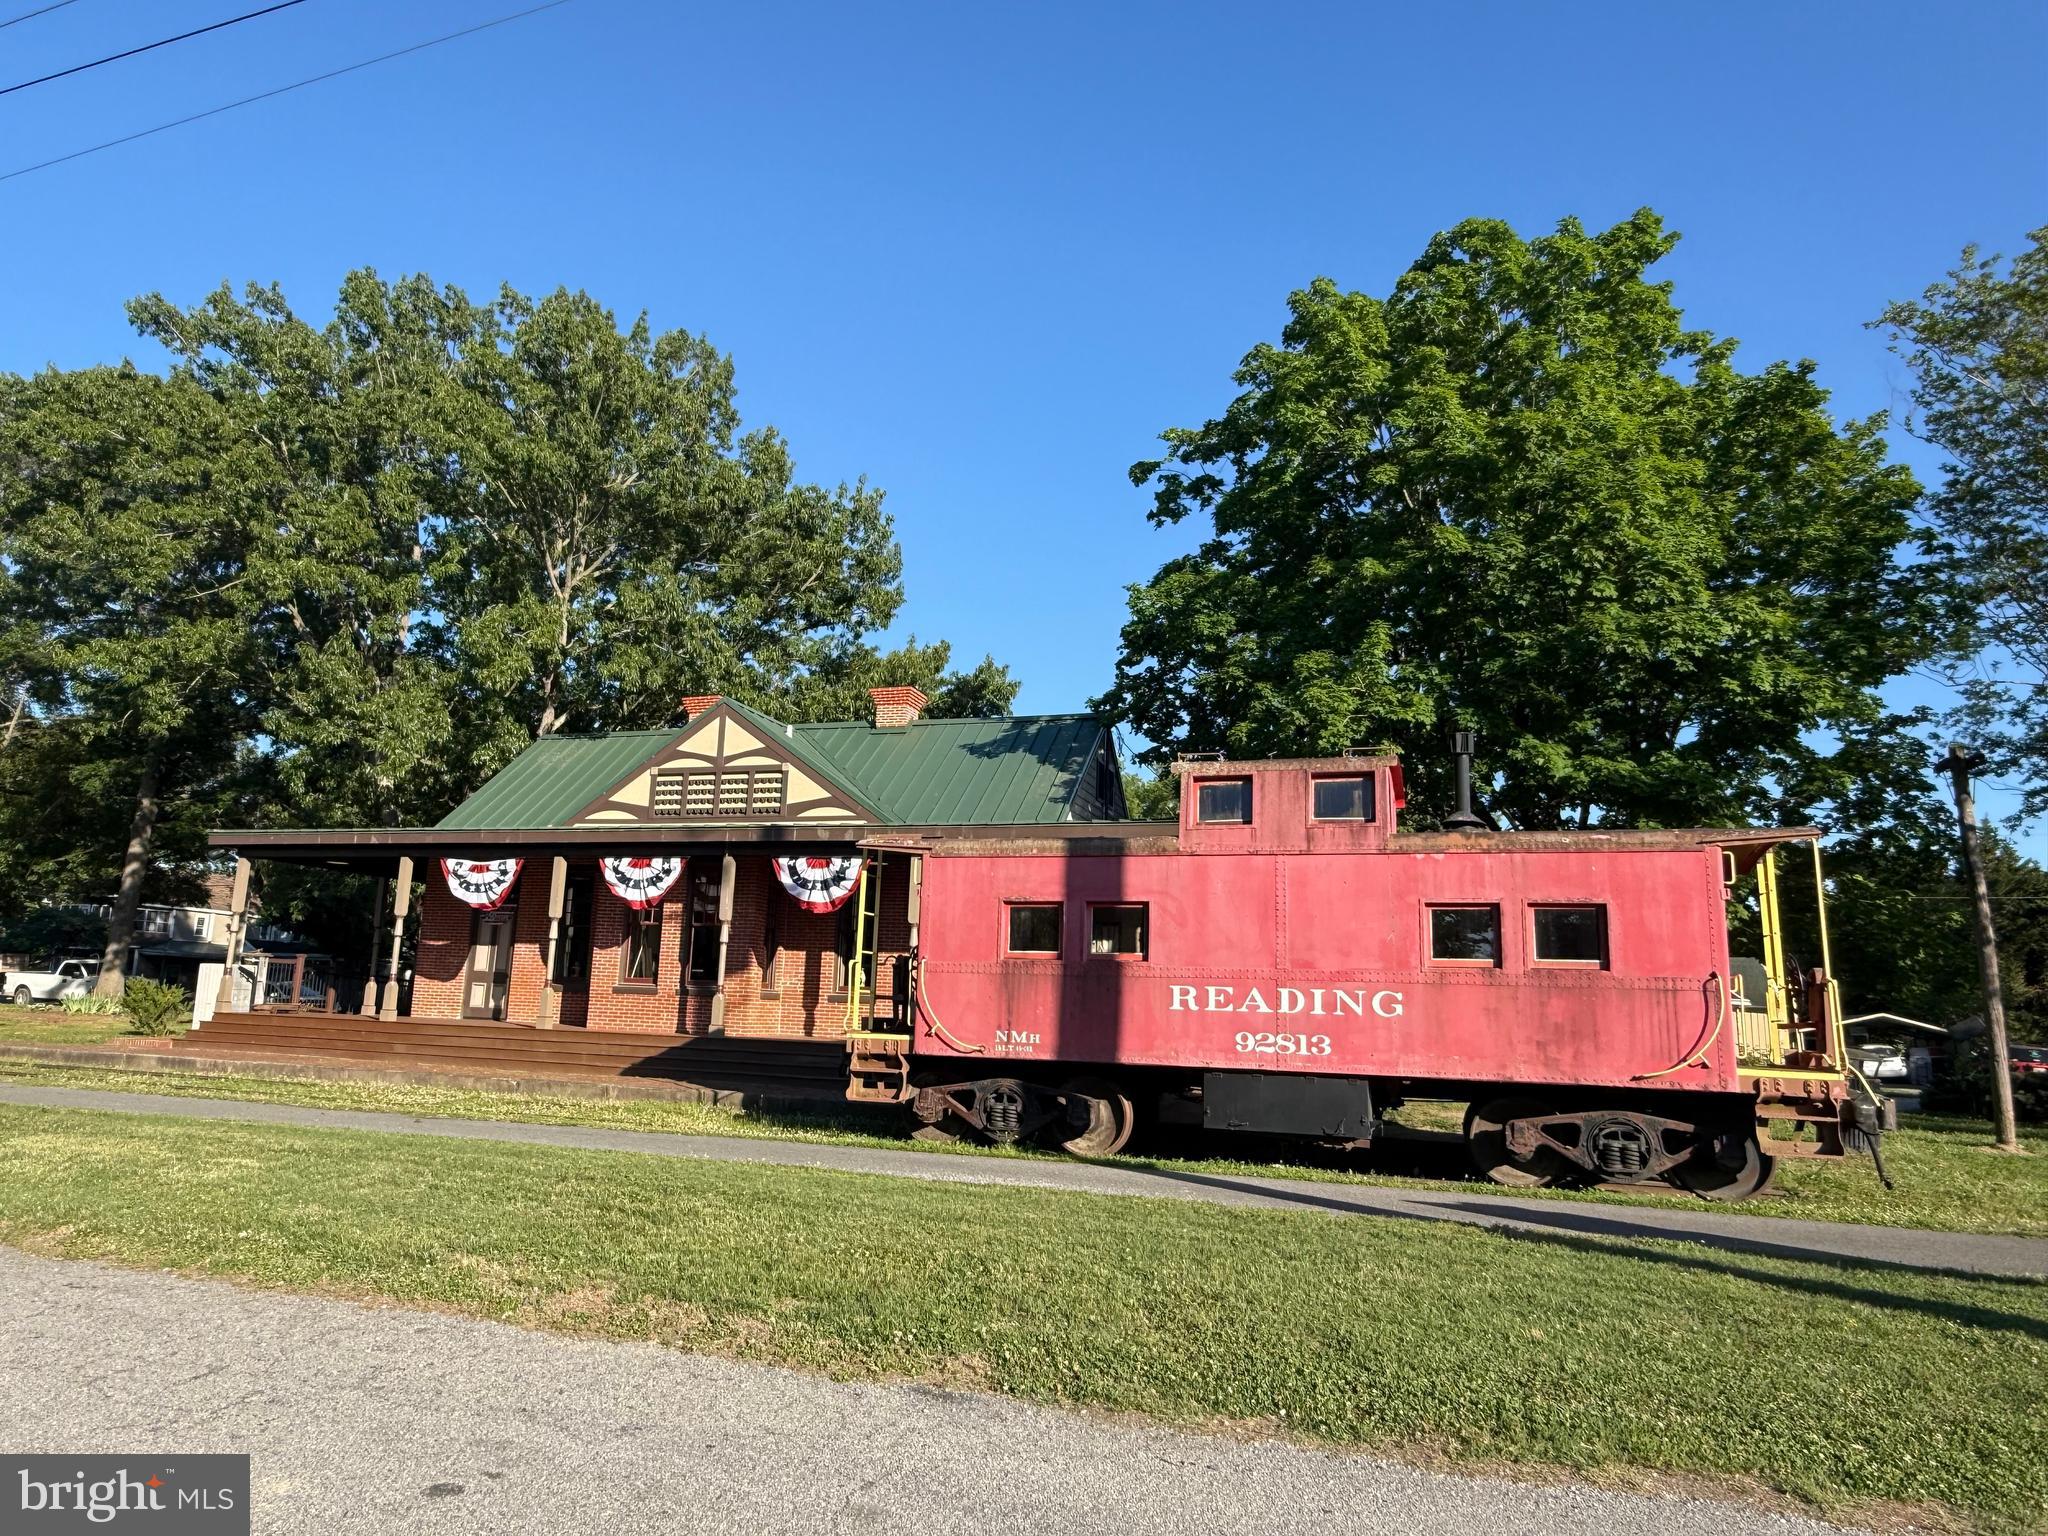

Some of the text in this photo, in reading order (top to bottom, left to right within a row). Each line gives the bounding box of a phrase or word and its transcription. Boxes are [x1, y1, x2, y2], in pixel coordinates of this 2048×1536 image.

[1168, 985, 1404, 1018] READING
[995, 1030, 1041, 1044] NMH
[1235, 1031, 1332, 1056] 92813
